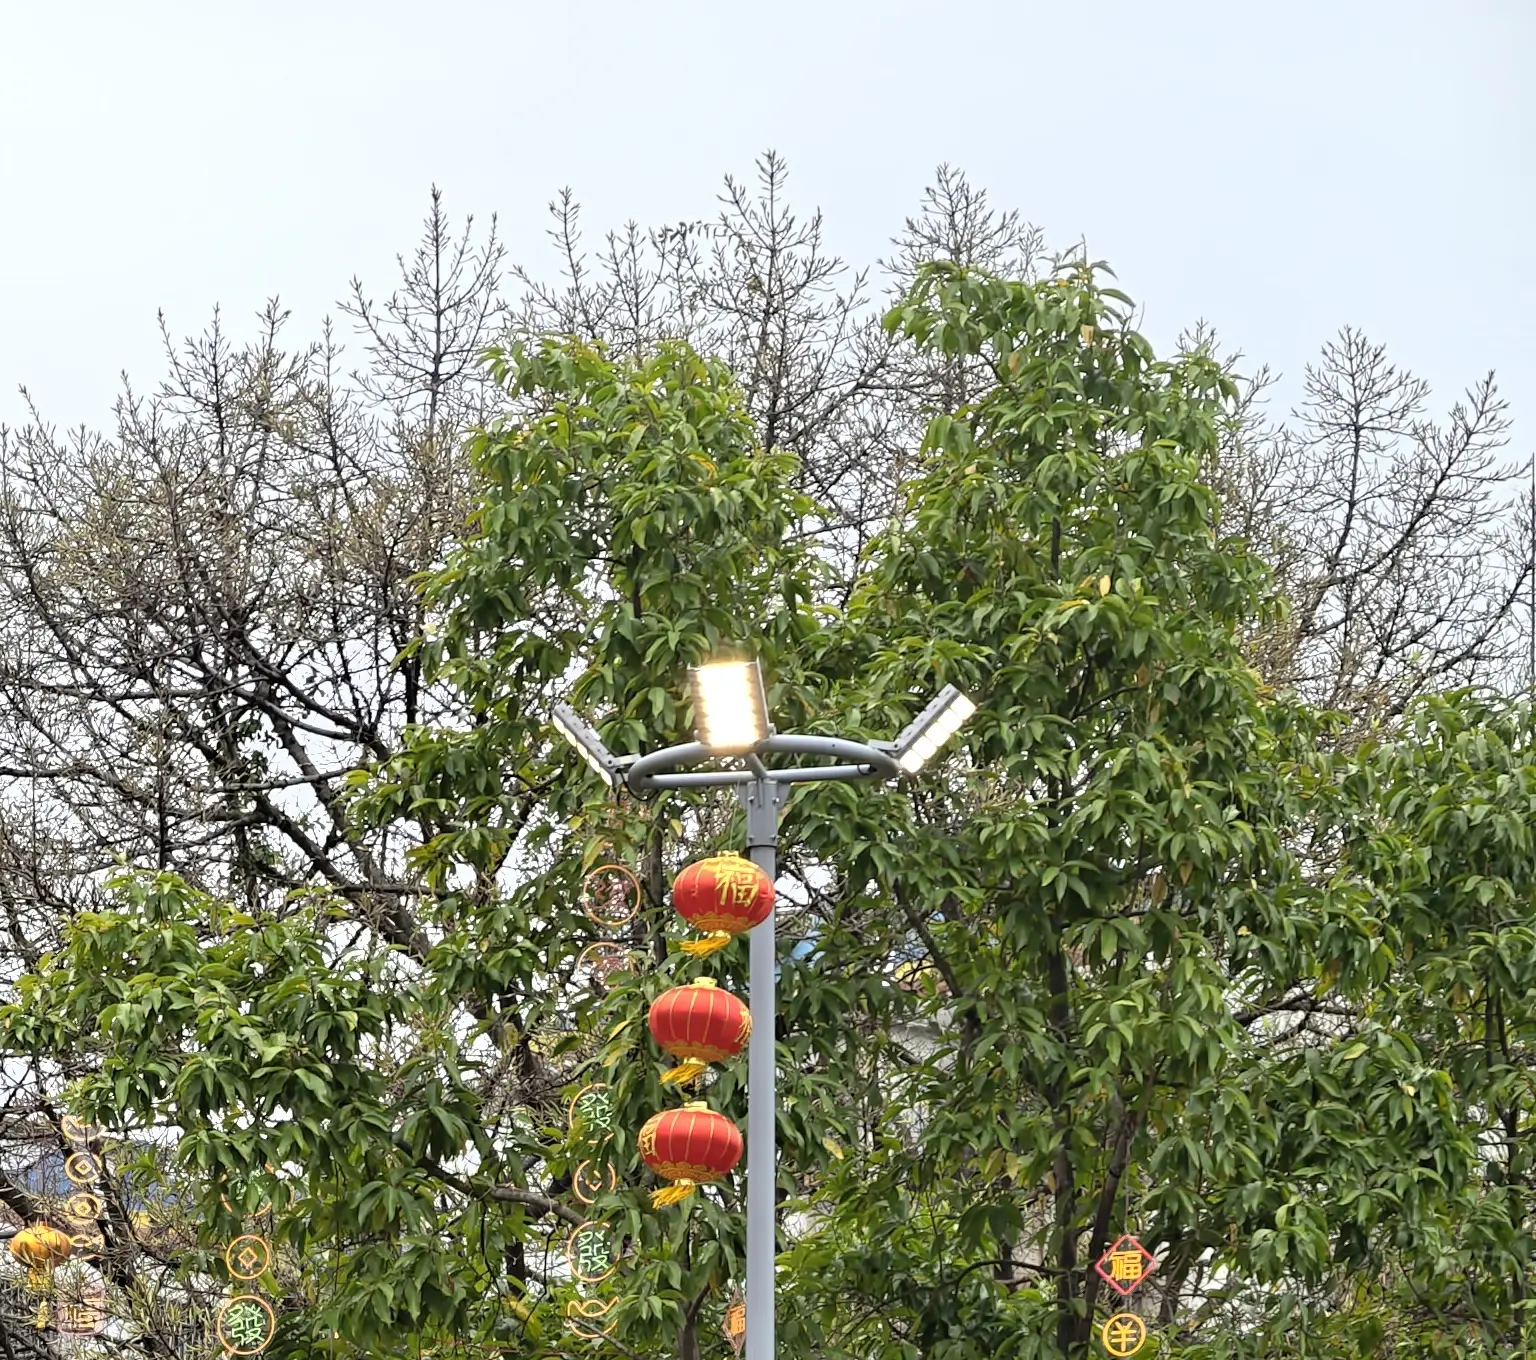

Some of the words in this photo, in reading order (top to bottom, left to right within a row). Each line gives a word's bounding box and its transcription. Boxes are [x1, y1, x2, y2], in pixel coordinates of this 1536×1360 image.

[717, 863, 757, 906] 福
[1110, 1250, 1143, 1282] 福
[227, 1303, 266, 1346] 發
